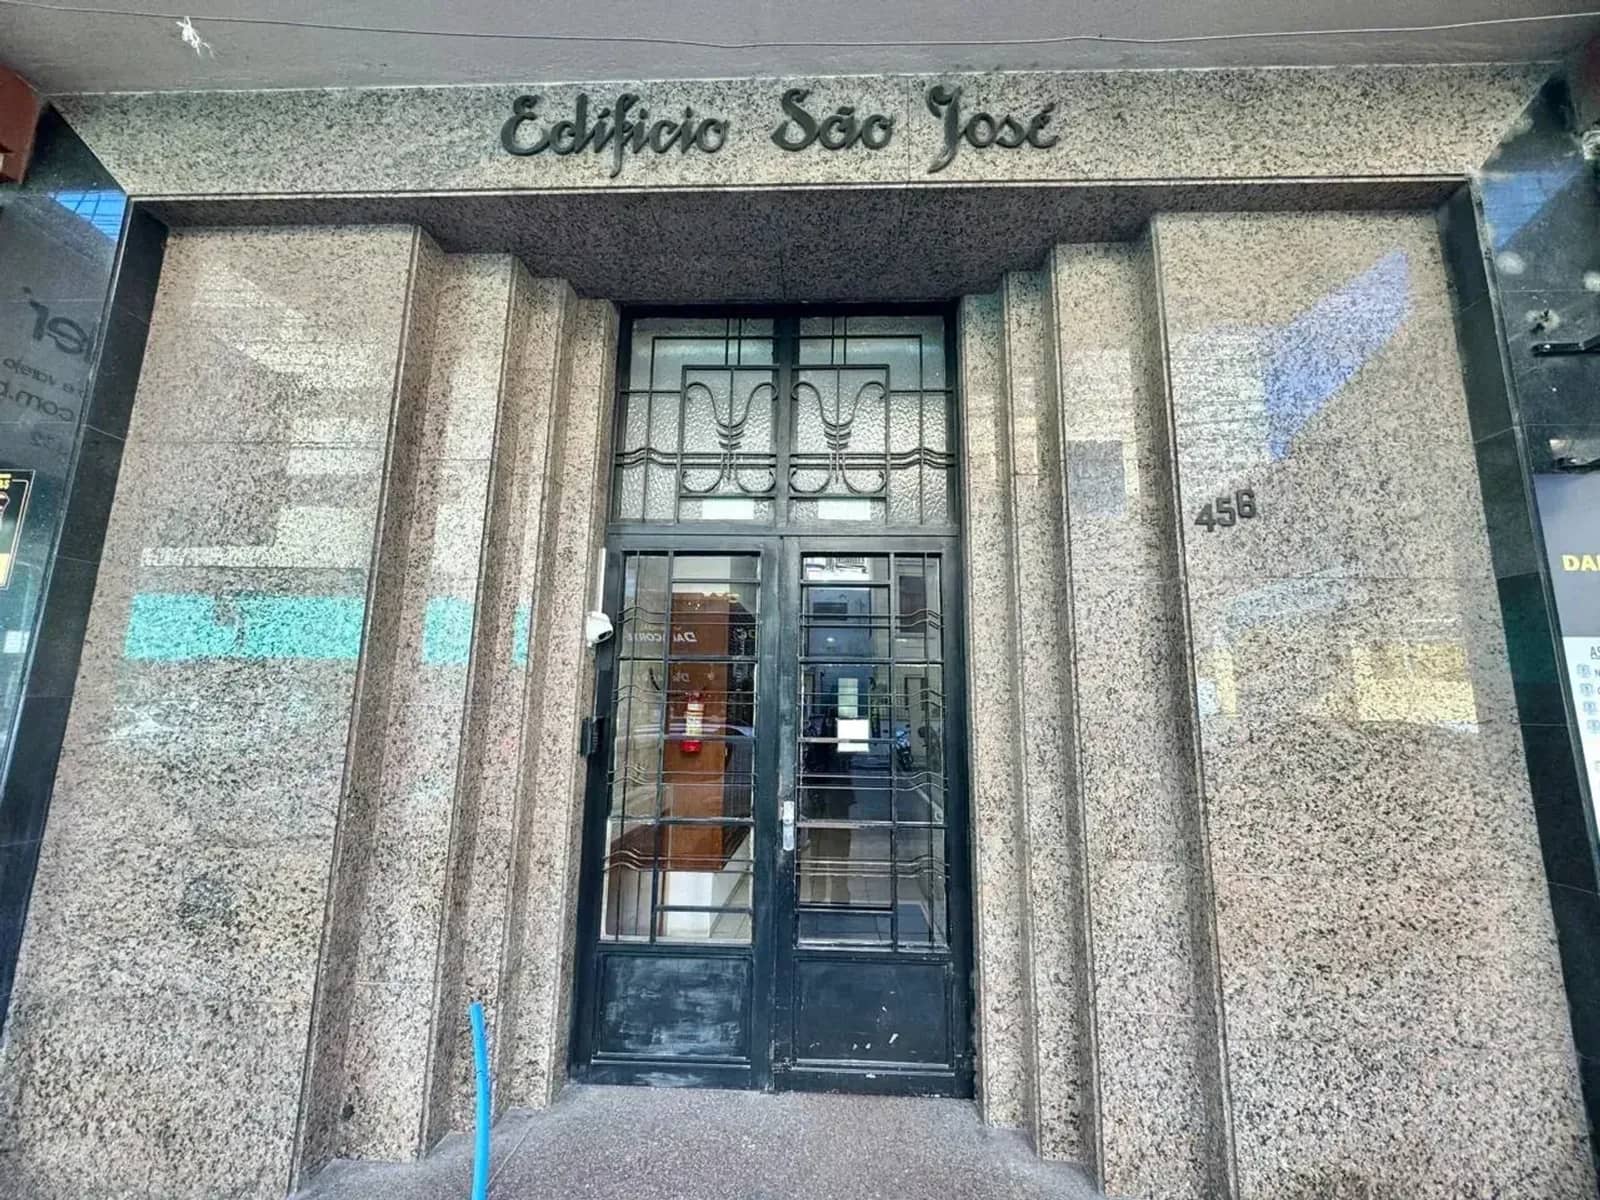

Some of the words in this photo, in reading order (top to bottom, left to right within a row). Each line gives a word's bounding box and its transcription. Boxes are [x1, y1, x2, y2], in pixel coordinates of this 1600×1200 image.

[770, 87, 894, 151] São
[926, 84, 1058, 173] José
[1194, 489, 1257, 533] 456
[1562, 554, 1600, 572] DA
